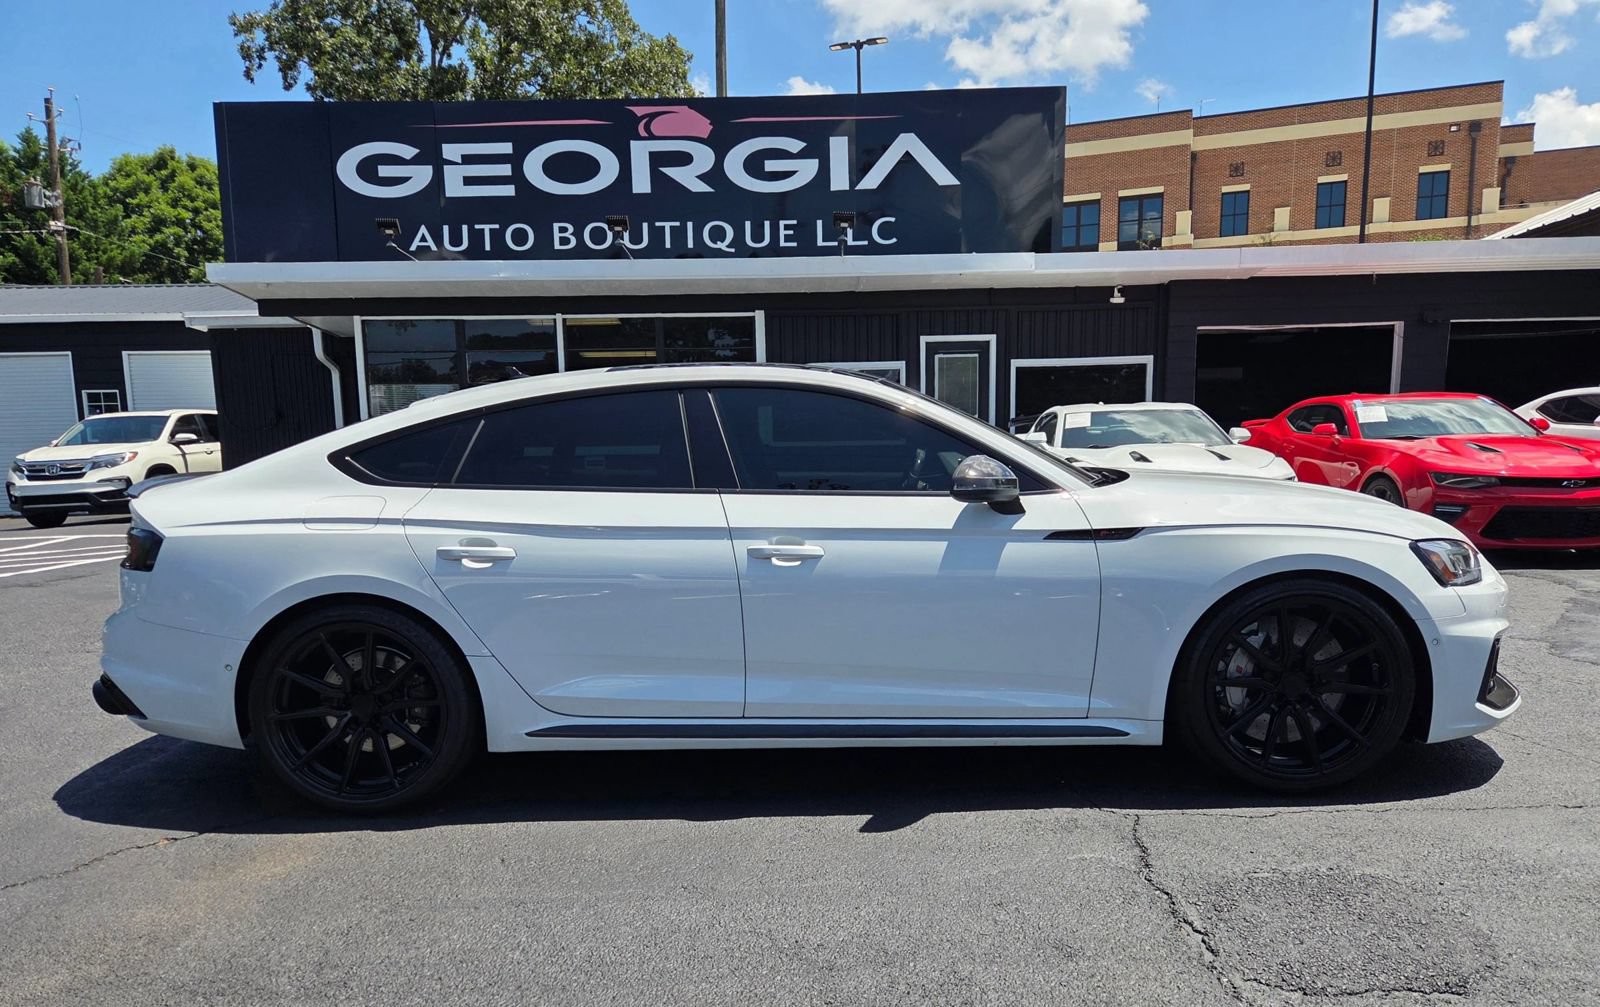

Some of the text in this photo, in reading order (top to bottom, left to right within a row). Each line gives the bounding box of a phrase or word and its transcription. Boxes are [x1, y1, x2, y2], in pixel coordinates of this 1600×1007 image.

[336, 132, 961, 198] GEORGIA
[408, 217, 898, 253] AUTO BOUTIQUE LLC
